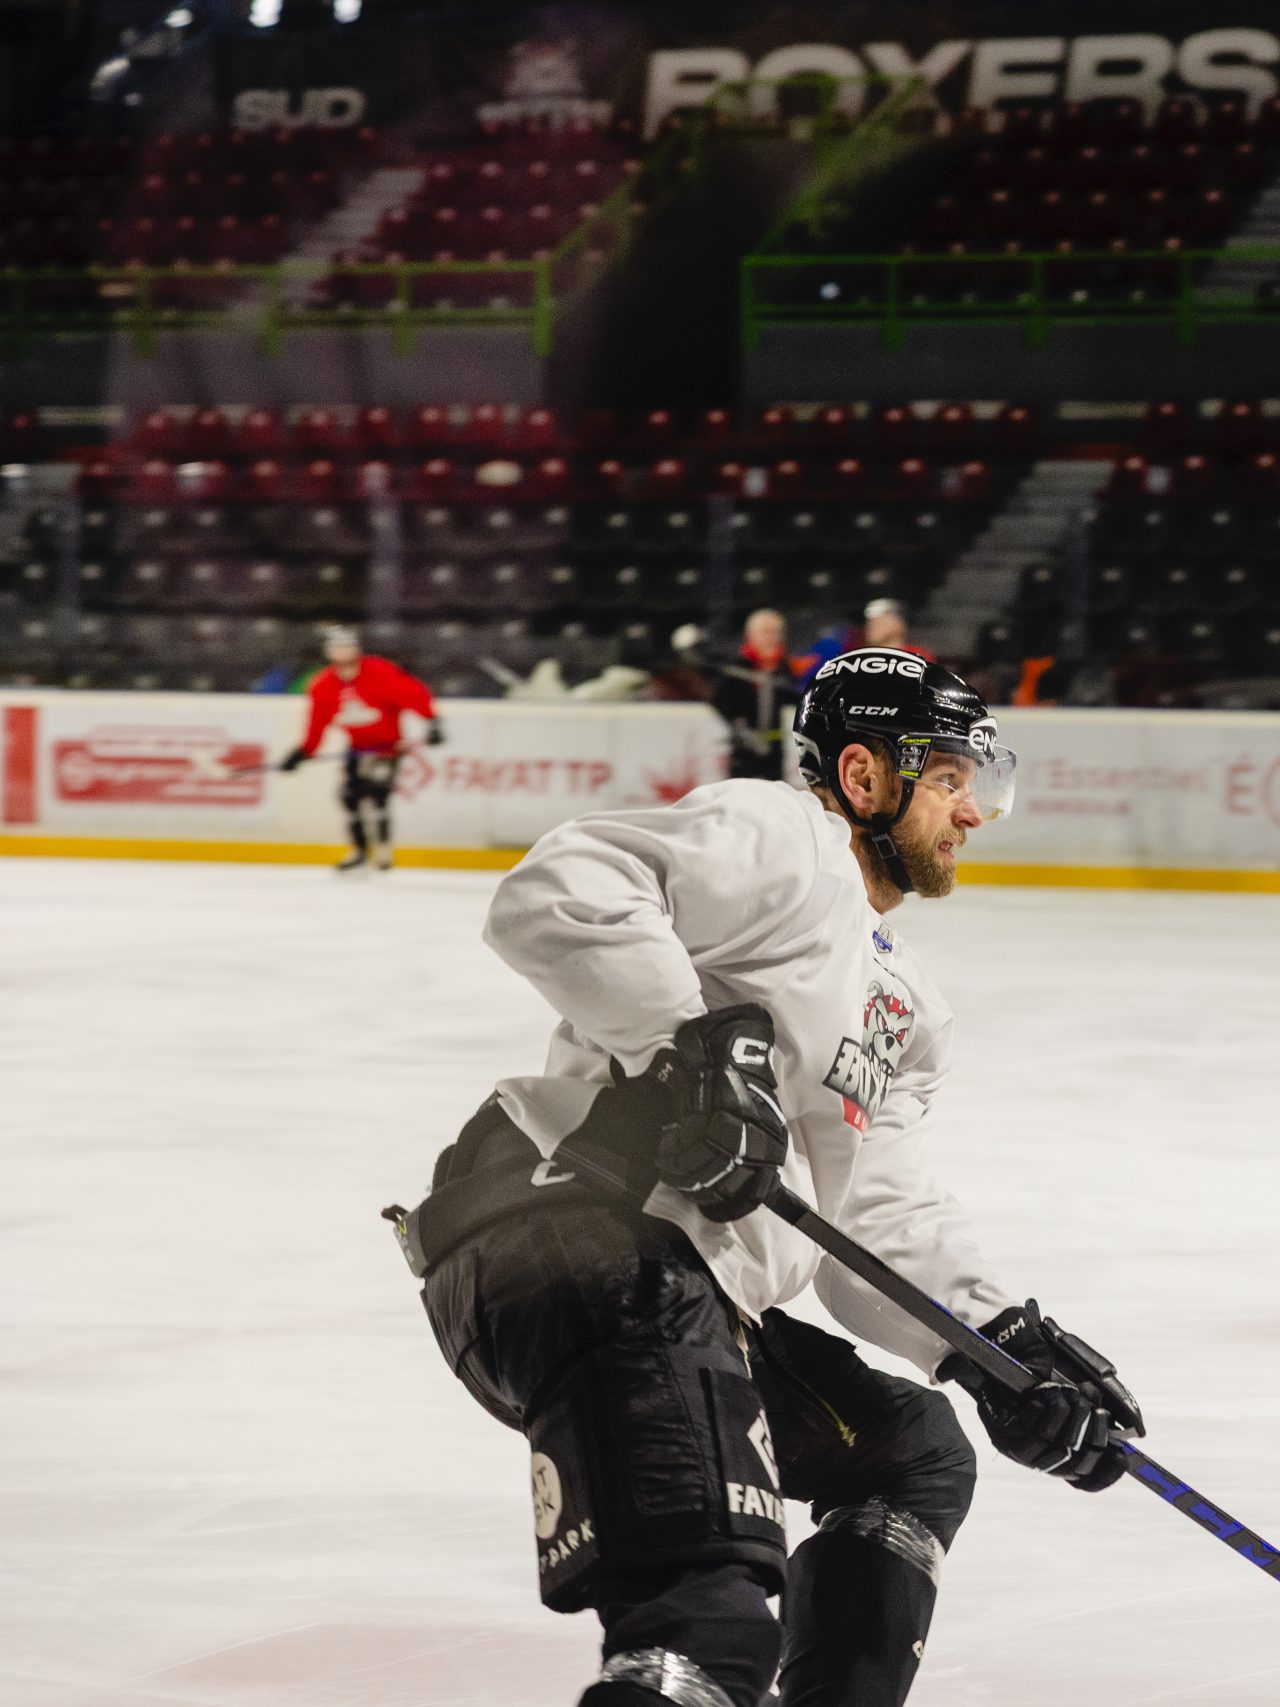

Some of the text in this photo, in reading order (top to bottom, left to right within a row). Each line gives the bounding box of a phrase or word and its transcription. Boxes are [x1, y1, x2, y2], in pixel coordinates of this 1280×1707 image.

[232, 87, 367, 131] SUD
[848, 705, 898, 716] CCM
[562, 759, 614, 796] TP
